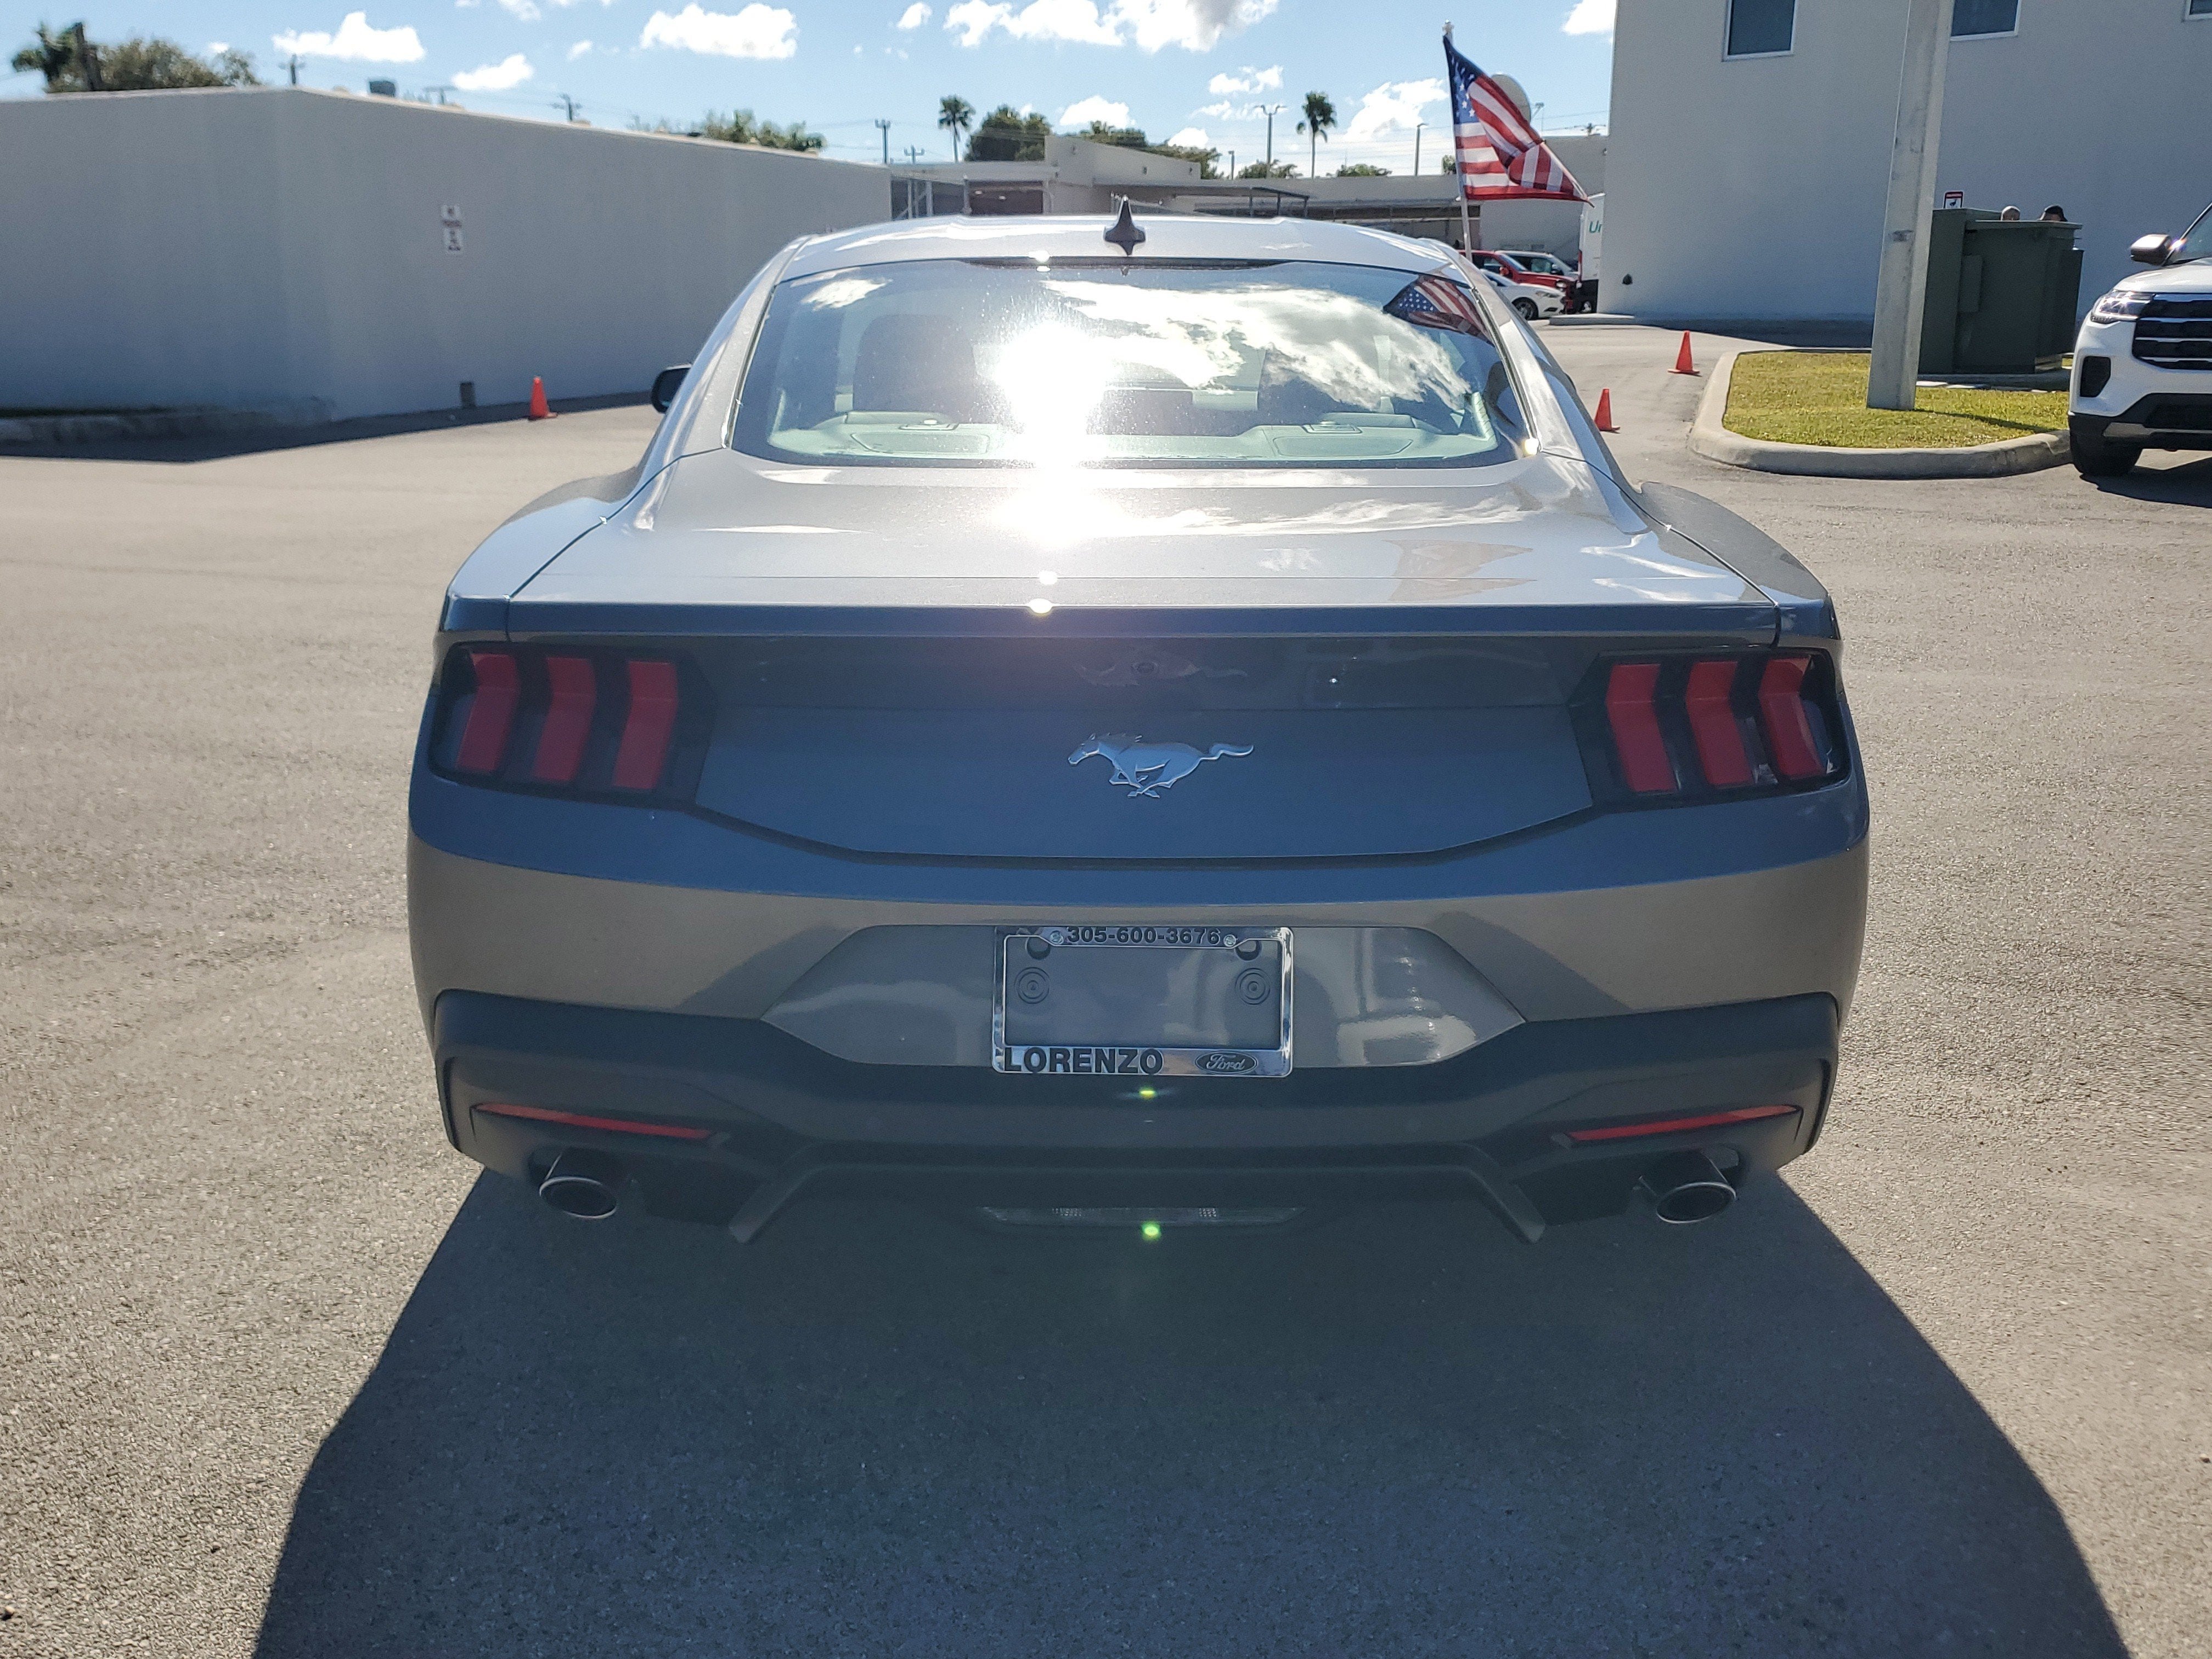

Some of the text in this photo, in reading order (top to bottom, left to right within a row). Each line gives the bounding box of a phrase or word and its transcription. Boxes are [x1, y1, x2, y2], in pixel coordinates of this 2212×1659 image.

[1066, 926, 1221, 944] 305-600-3676
[1004, 1047, 1247, 1074] LORENZO Ford
